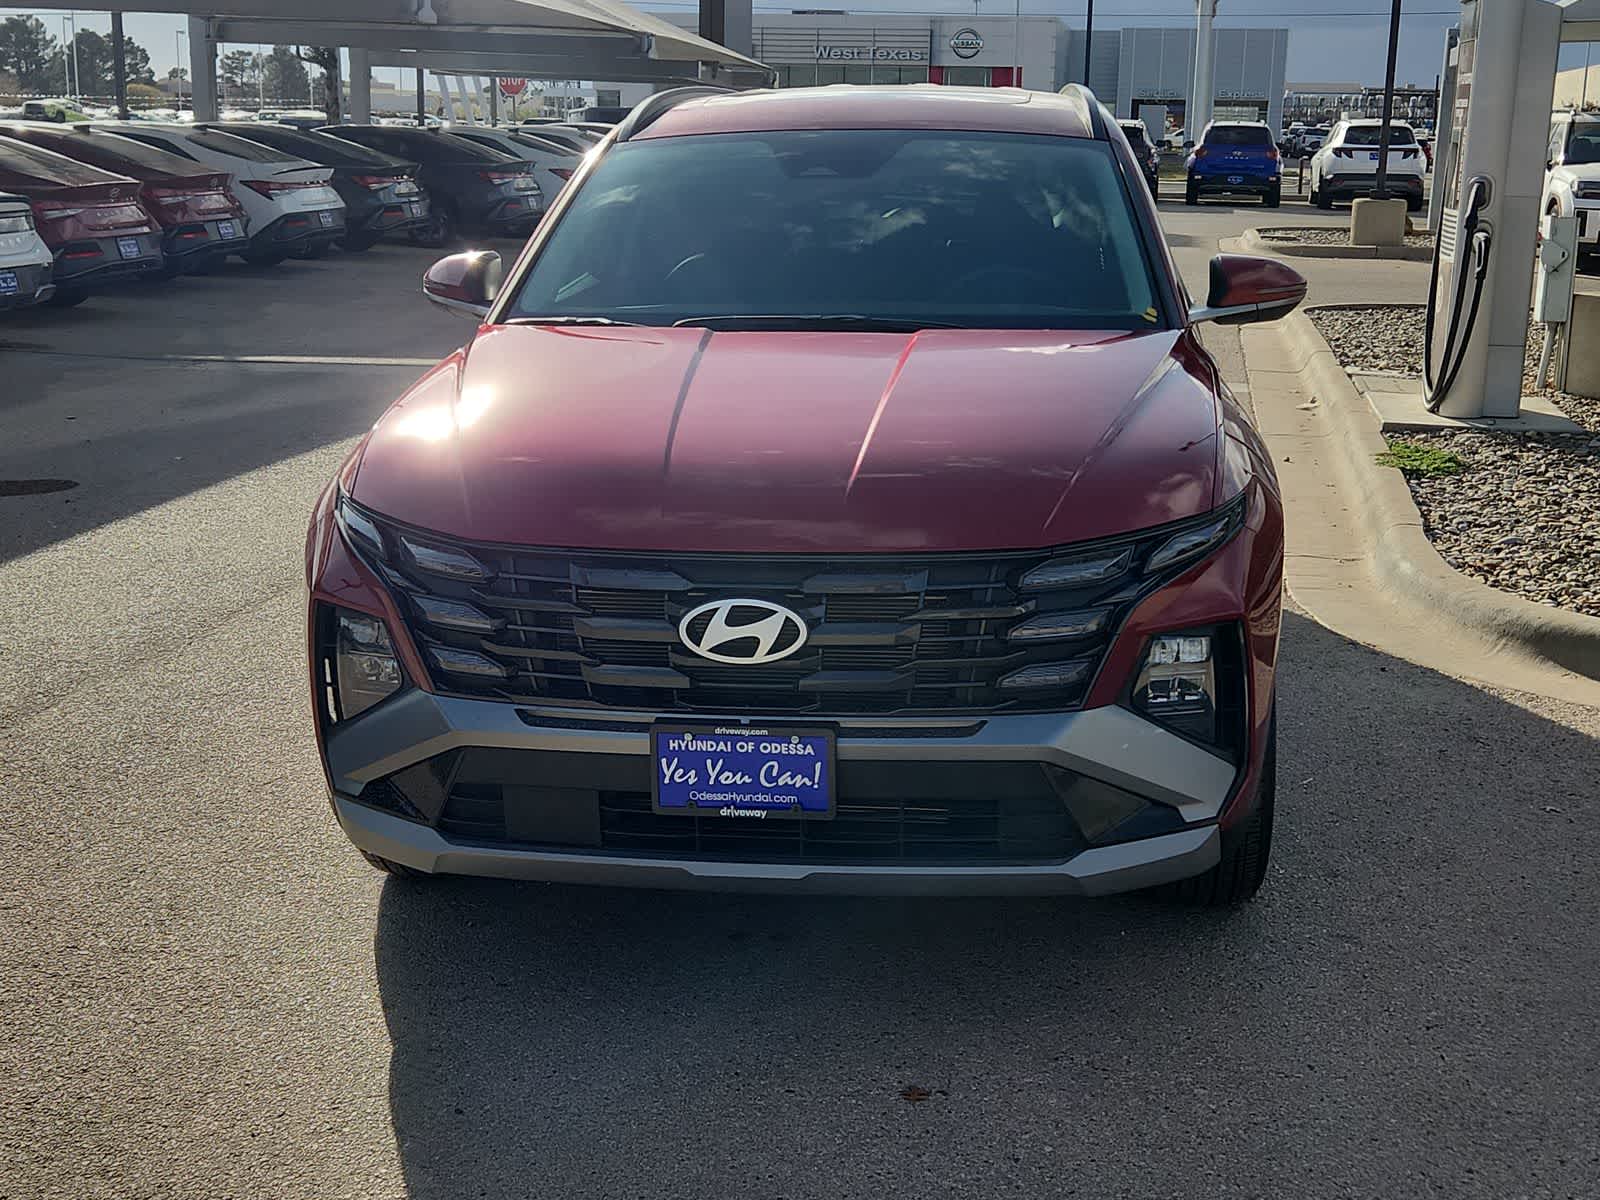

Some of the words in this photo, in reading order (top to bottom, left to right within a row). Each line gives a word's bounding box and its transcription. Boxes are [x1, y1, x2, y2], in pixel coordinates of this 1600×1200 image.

[814, 45, 863, 59] West
[867, 47, 922, 61] Texas
[500, 77, 523, 86] STOP
[714, 727, 769, 737] driveway.com
[669, 739, 731, 753] HYUNDAI
[736, 742, 755, 754] OF
[759, 743, 815, 756] ODESSA
[661, 757, 698, 785] Yes
[705, 758, 753, 785] You
[759, 760, 822, 789] Can!
[689, 790, 798, 804] OdessaHyundai.com
[719, 805, 768, 819] driveway
